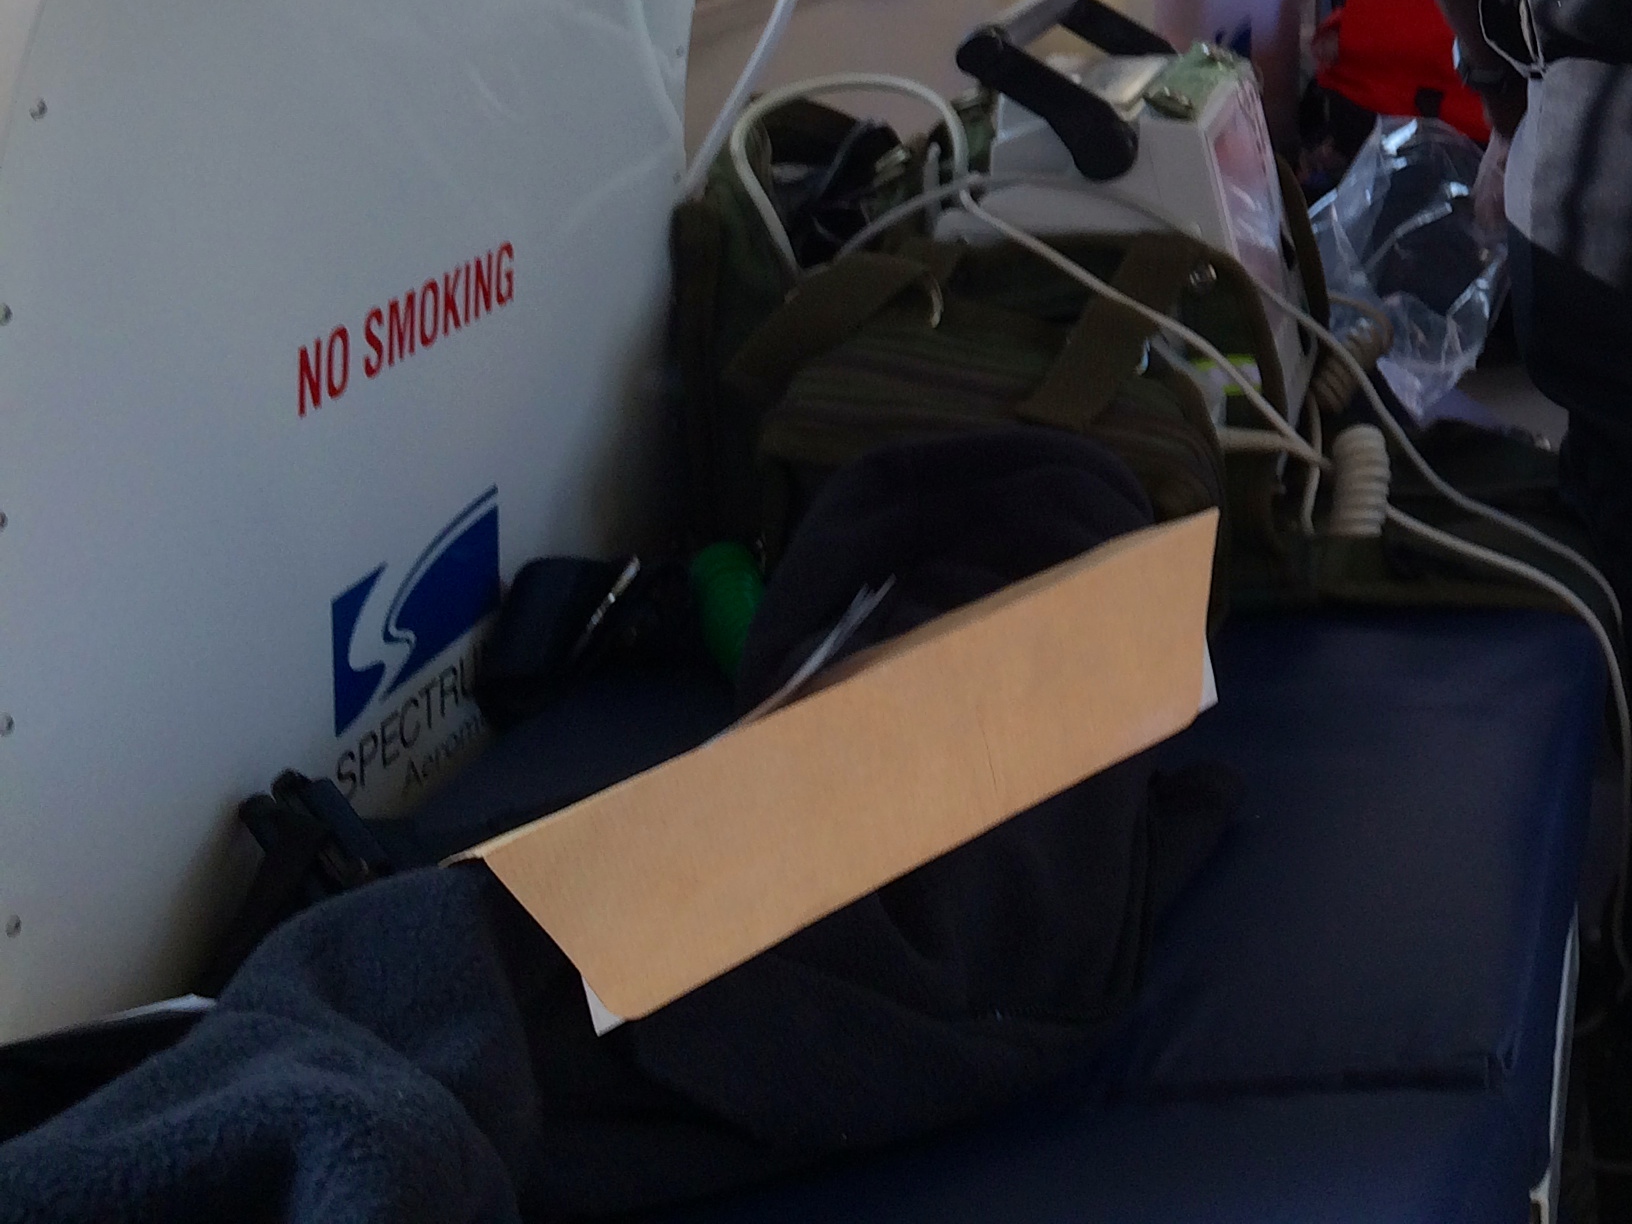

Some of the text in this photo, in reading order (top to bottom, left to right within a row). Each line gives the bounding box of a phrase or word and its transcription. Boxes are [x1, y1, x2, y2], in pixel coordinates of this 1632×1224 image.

[298, 240, 514, 419] NO SMOKING
[336, 640, 483, 798] SPECTRU
